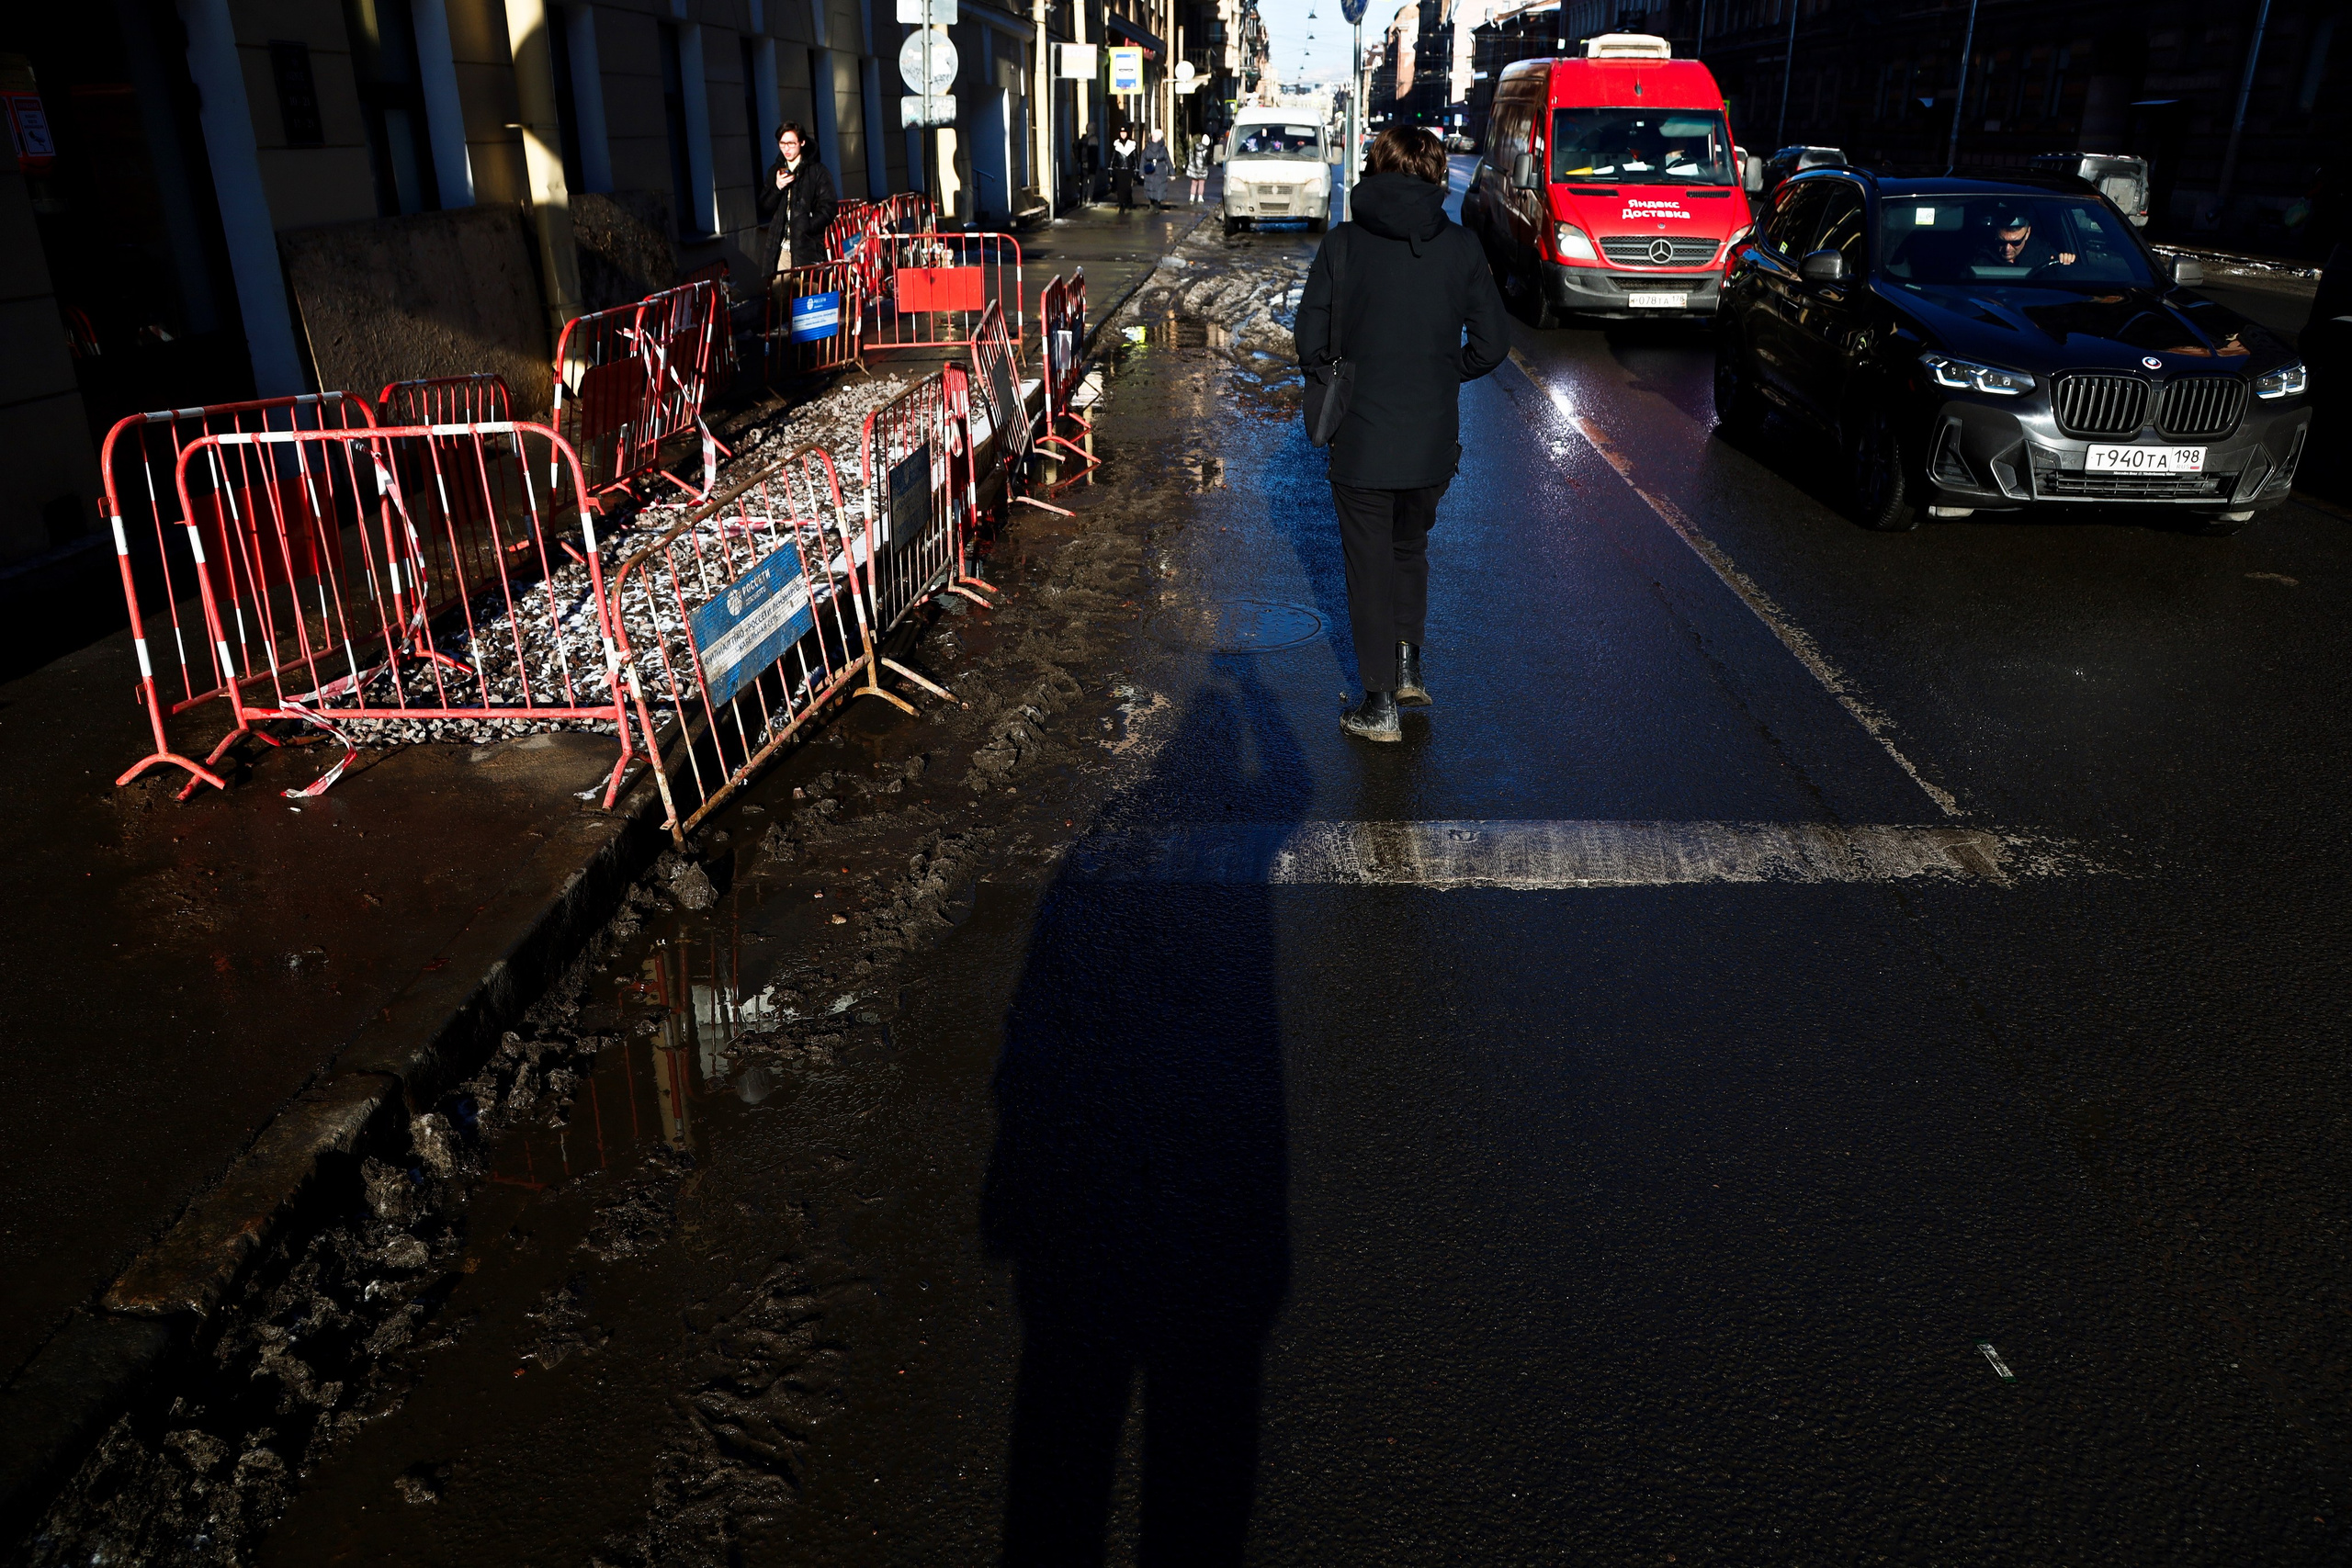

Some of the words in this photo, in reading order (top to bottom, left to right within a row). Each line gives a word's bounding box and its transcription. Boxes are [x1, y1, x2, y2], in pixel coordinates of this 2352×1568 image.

[1628, 199, 1680, 209] Яндекс
[1622, 209, 1690, 220] Доставка
[2096, 449, 2167, 468] Т940ТА
[2174, 449, 2199, 464] 198
[741, 568, 771, 595] РОССЕТИ
[705, 637, 731, 665] ФИЛИАЛ
